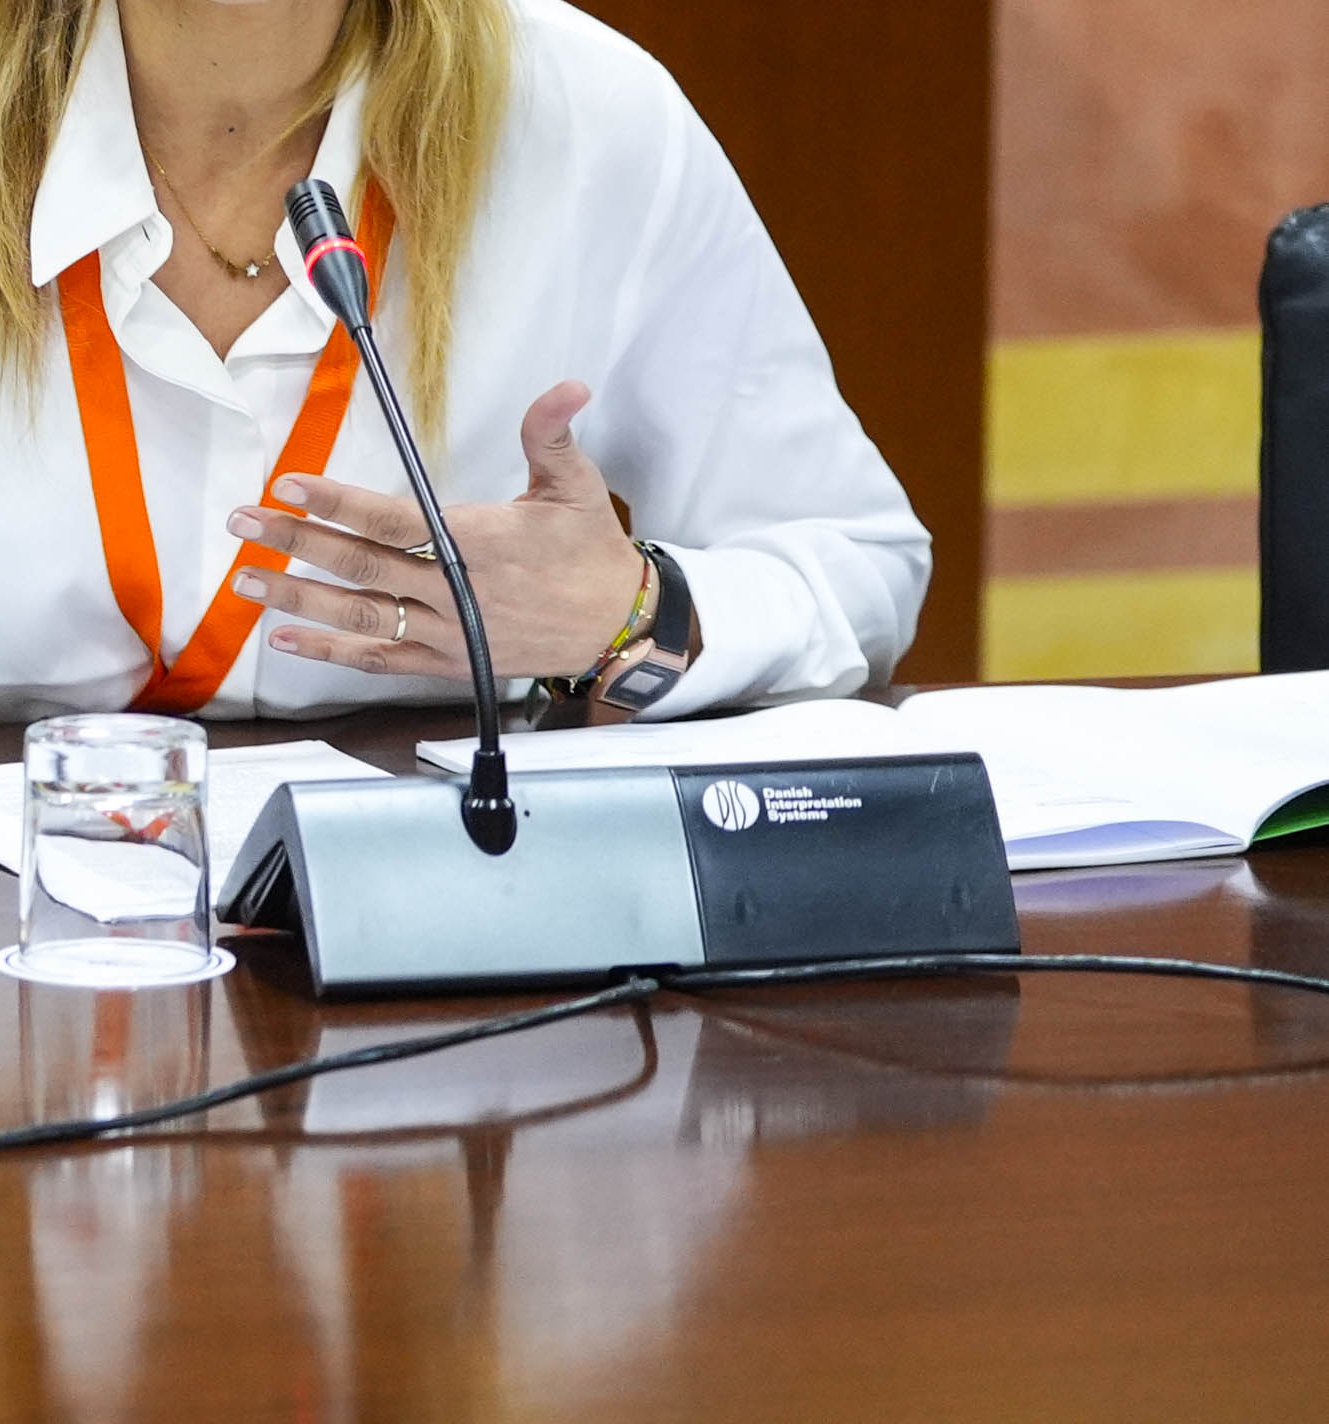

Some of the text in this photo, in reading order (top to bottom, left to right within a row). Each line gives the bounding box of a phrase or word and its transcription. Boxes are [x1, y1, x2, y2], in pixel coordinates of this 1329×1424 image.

[762, 786, 813, 800] Danish
[765, 795, 862, 811] Interpretation
[767, 809, 829, 824] Systems
